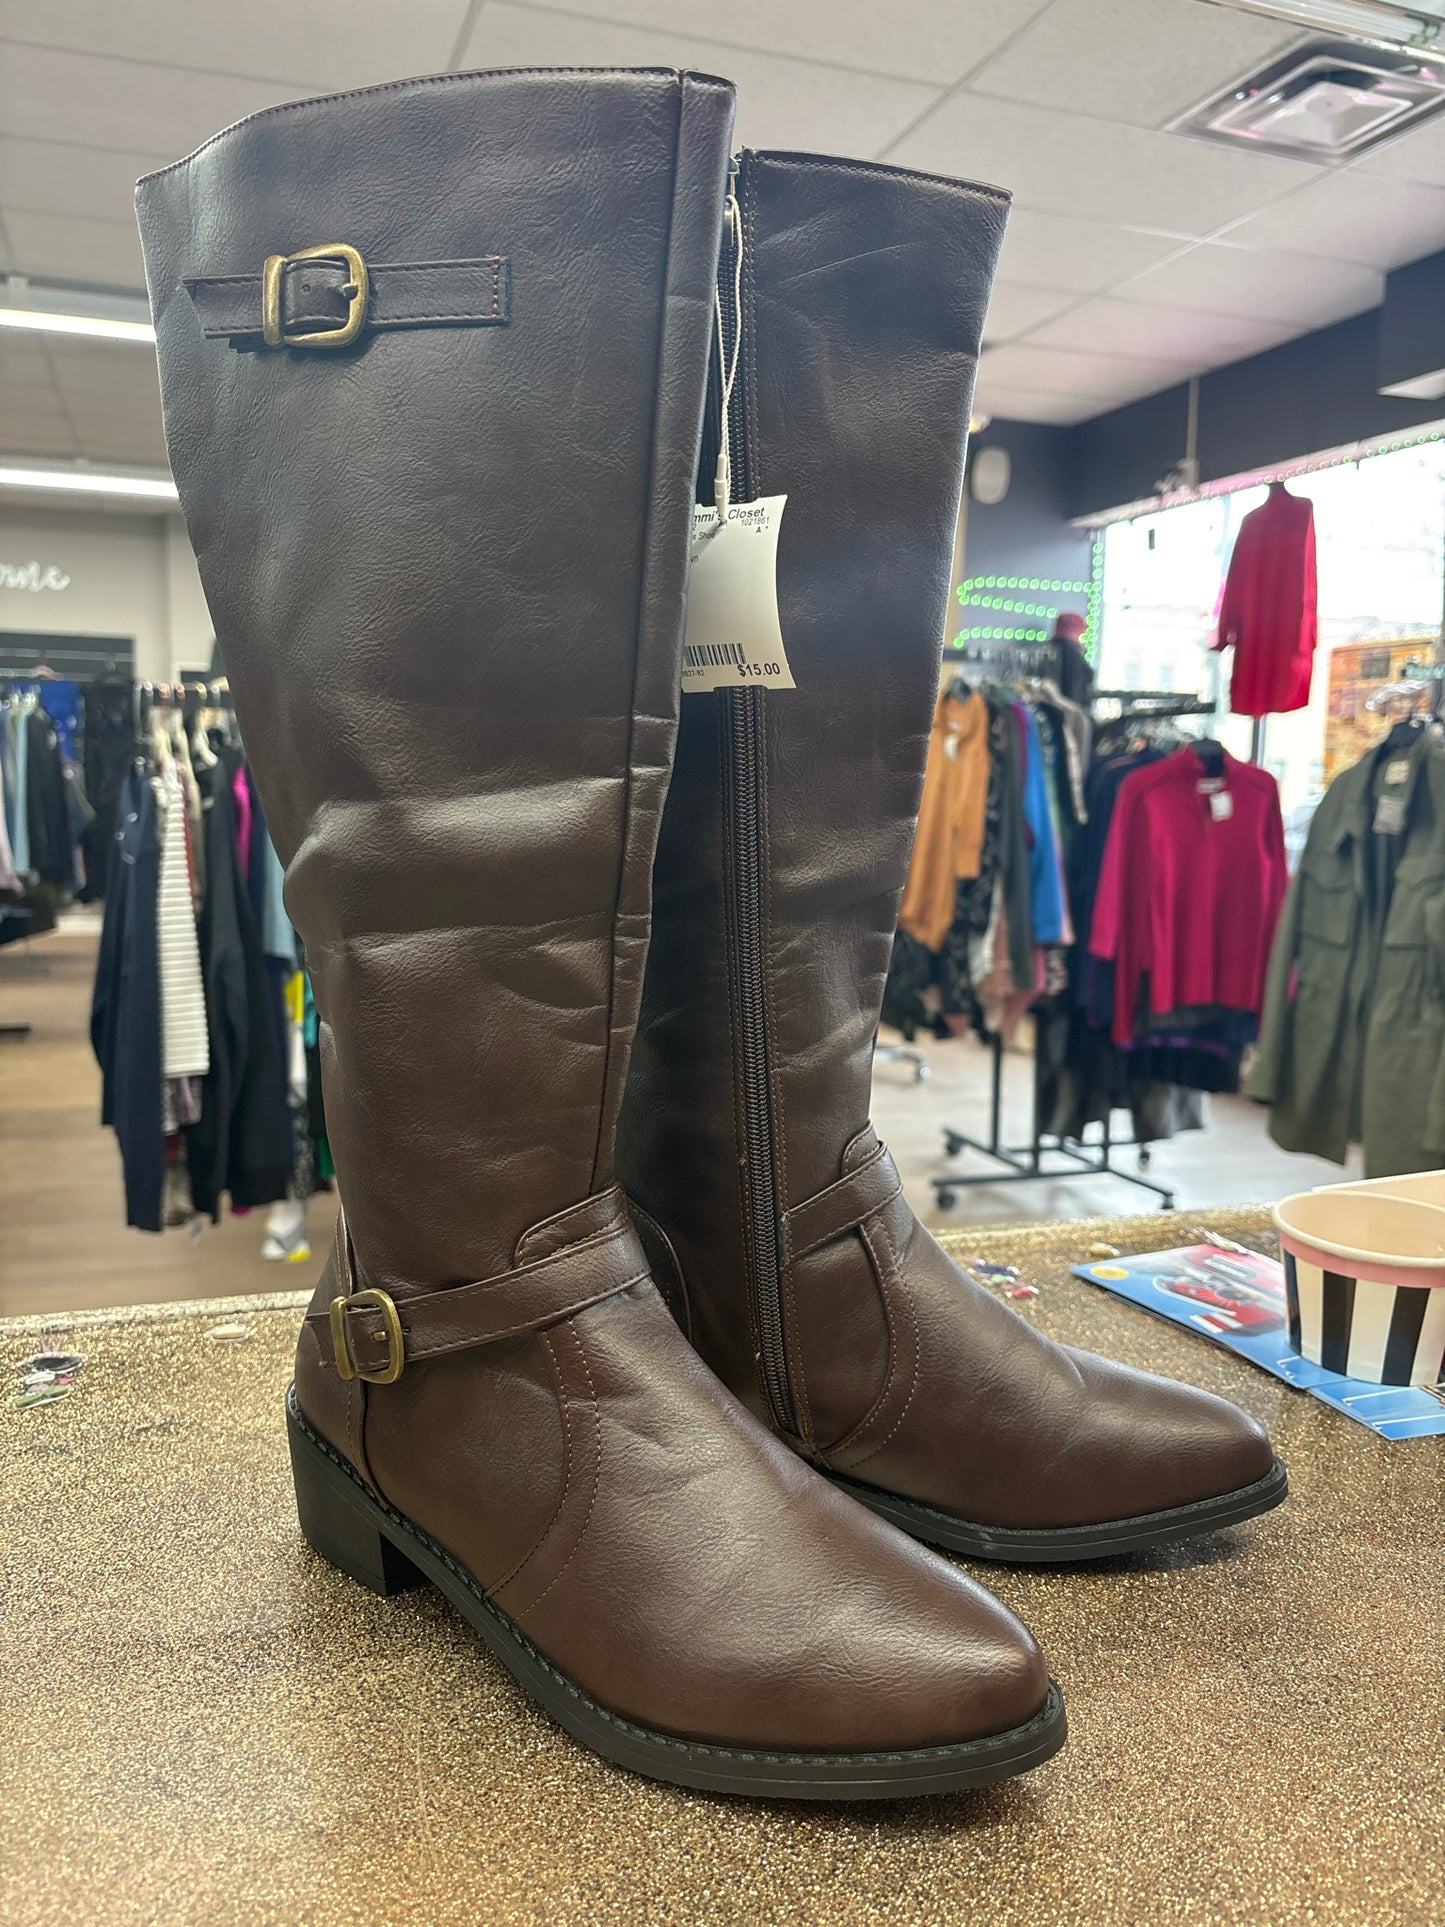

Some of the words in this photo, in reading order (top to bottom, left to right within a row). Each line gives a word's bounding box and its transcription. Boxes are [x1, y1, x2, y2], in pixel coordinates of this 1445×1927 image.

[728, 507, 765, 520] Closet
[741, 516, 770, 526] 1021861
[736, 662, 781, 678] $15.00
